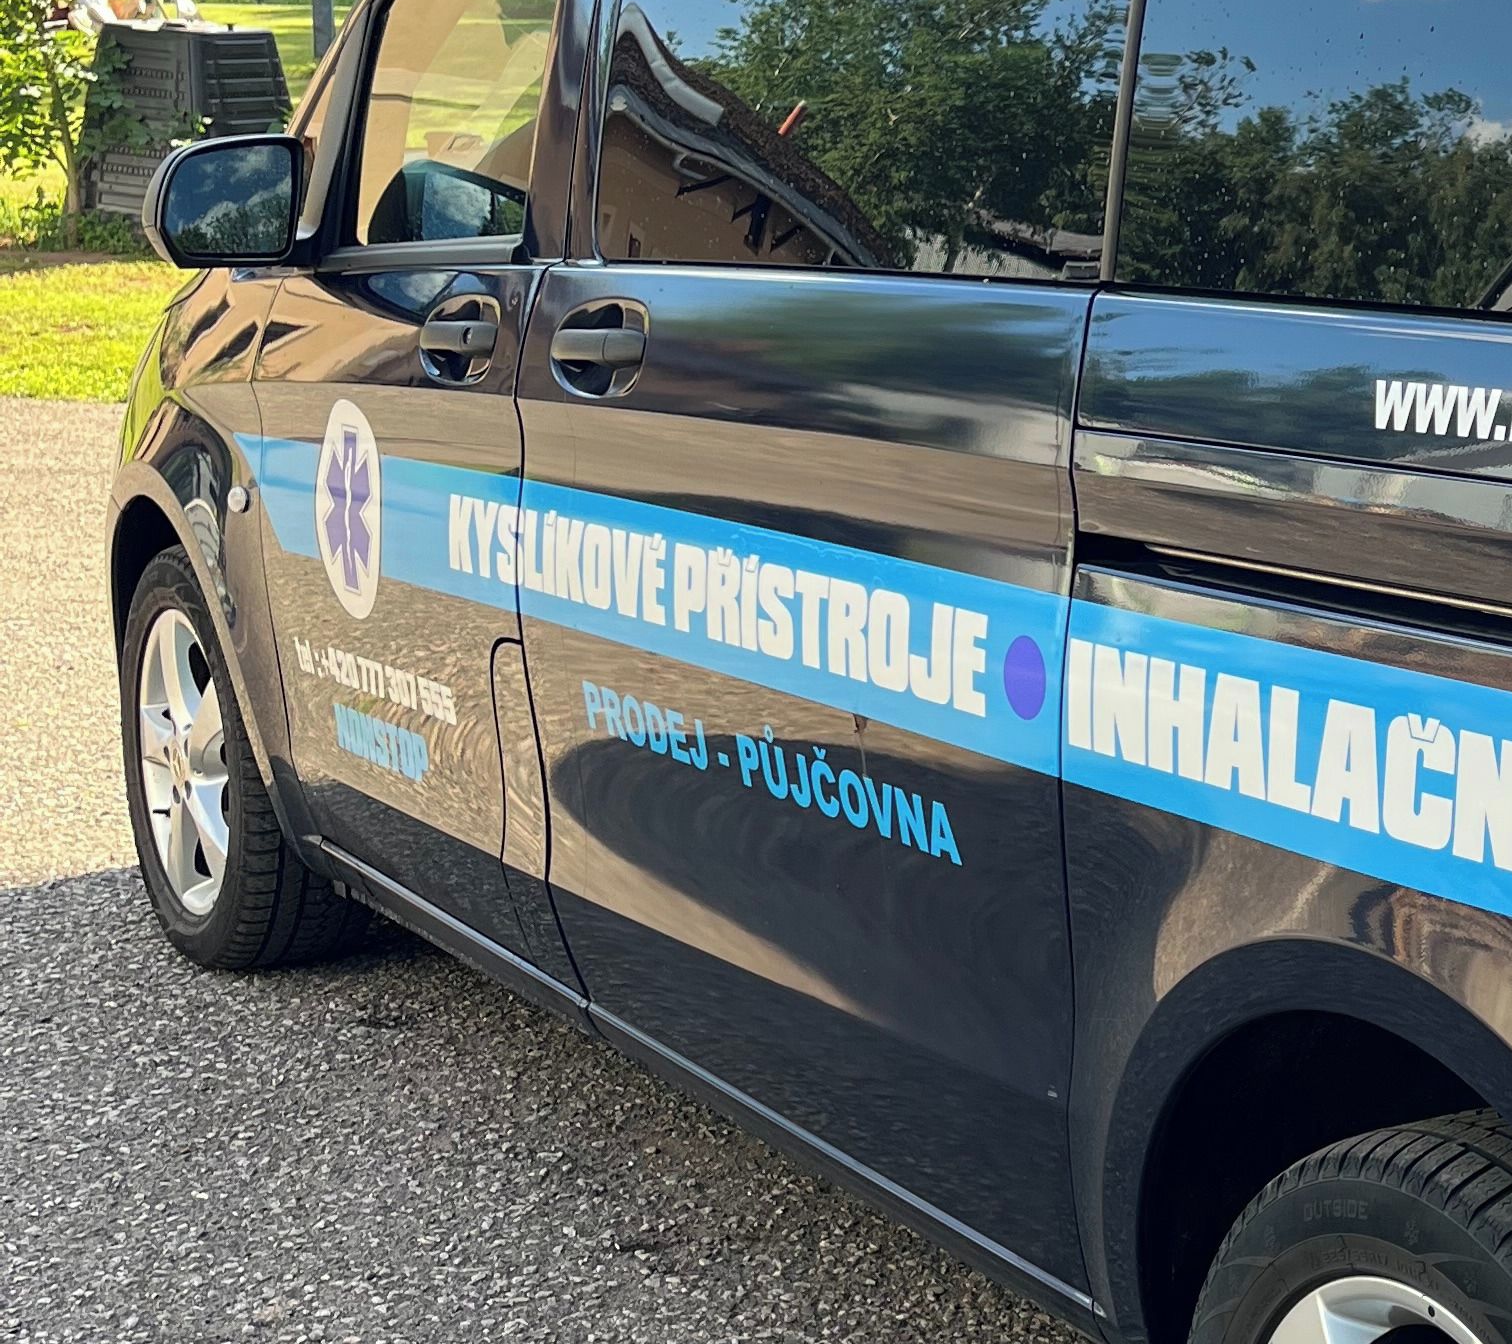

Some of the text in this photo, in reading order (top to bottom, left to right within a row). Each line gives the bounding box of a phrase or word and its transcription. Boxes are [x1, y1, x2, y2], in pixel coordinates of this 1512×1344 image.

[449, 493, 666, 626] KYSLÍKOVÉ
[674, 542, 988, 718] PŘÍSTROJE
[417, 676, 457, 726] 555
[333, 703, 429, 782] NONSTOP
[582, 680, 709, 770] PRODEJ
[736, 724, 963, 866] PŮJČOVNA
[1304, 1199, 1368, 1222] OUTSIDE
